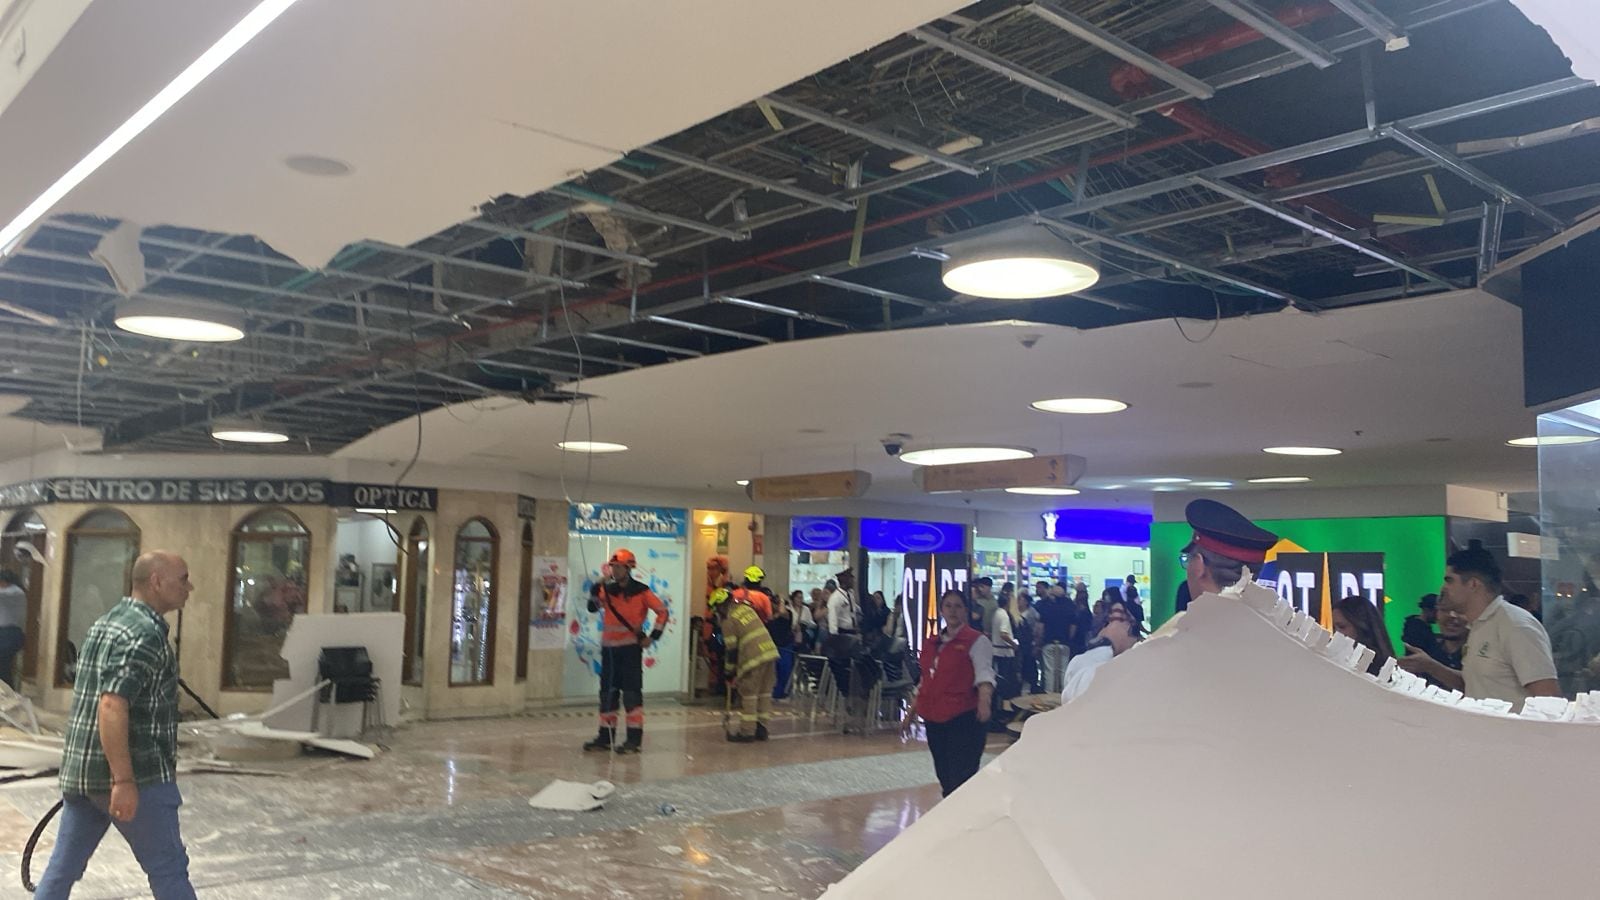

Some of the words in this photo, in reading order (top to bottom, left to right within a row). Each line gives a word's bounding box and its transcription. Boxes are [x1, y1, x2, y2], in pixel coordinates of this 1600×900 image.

[54, 478, 155, 500] CENTRO
[161, 481, 191, 501] DE
[198, 482, 248, 501] SUS
[254, 482, 325, 502] OJOS
[354, 486, 432, 509] OPTICA
[902, 553, 967, 659] STA
